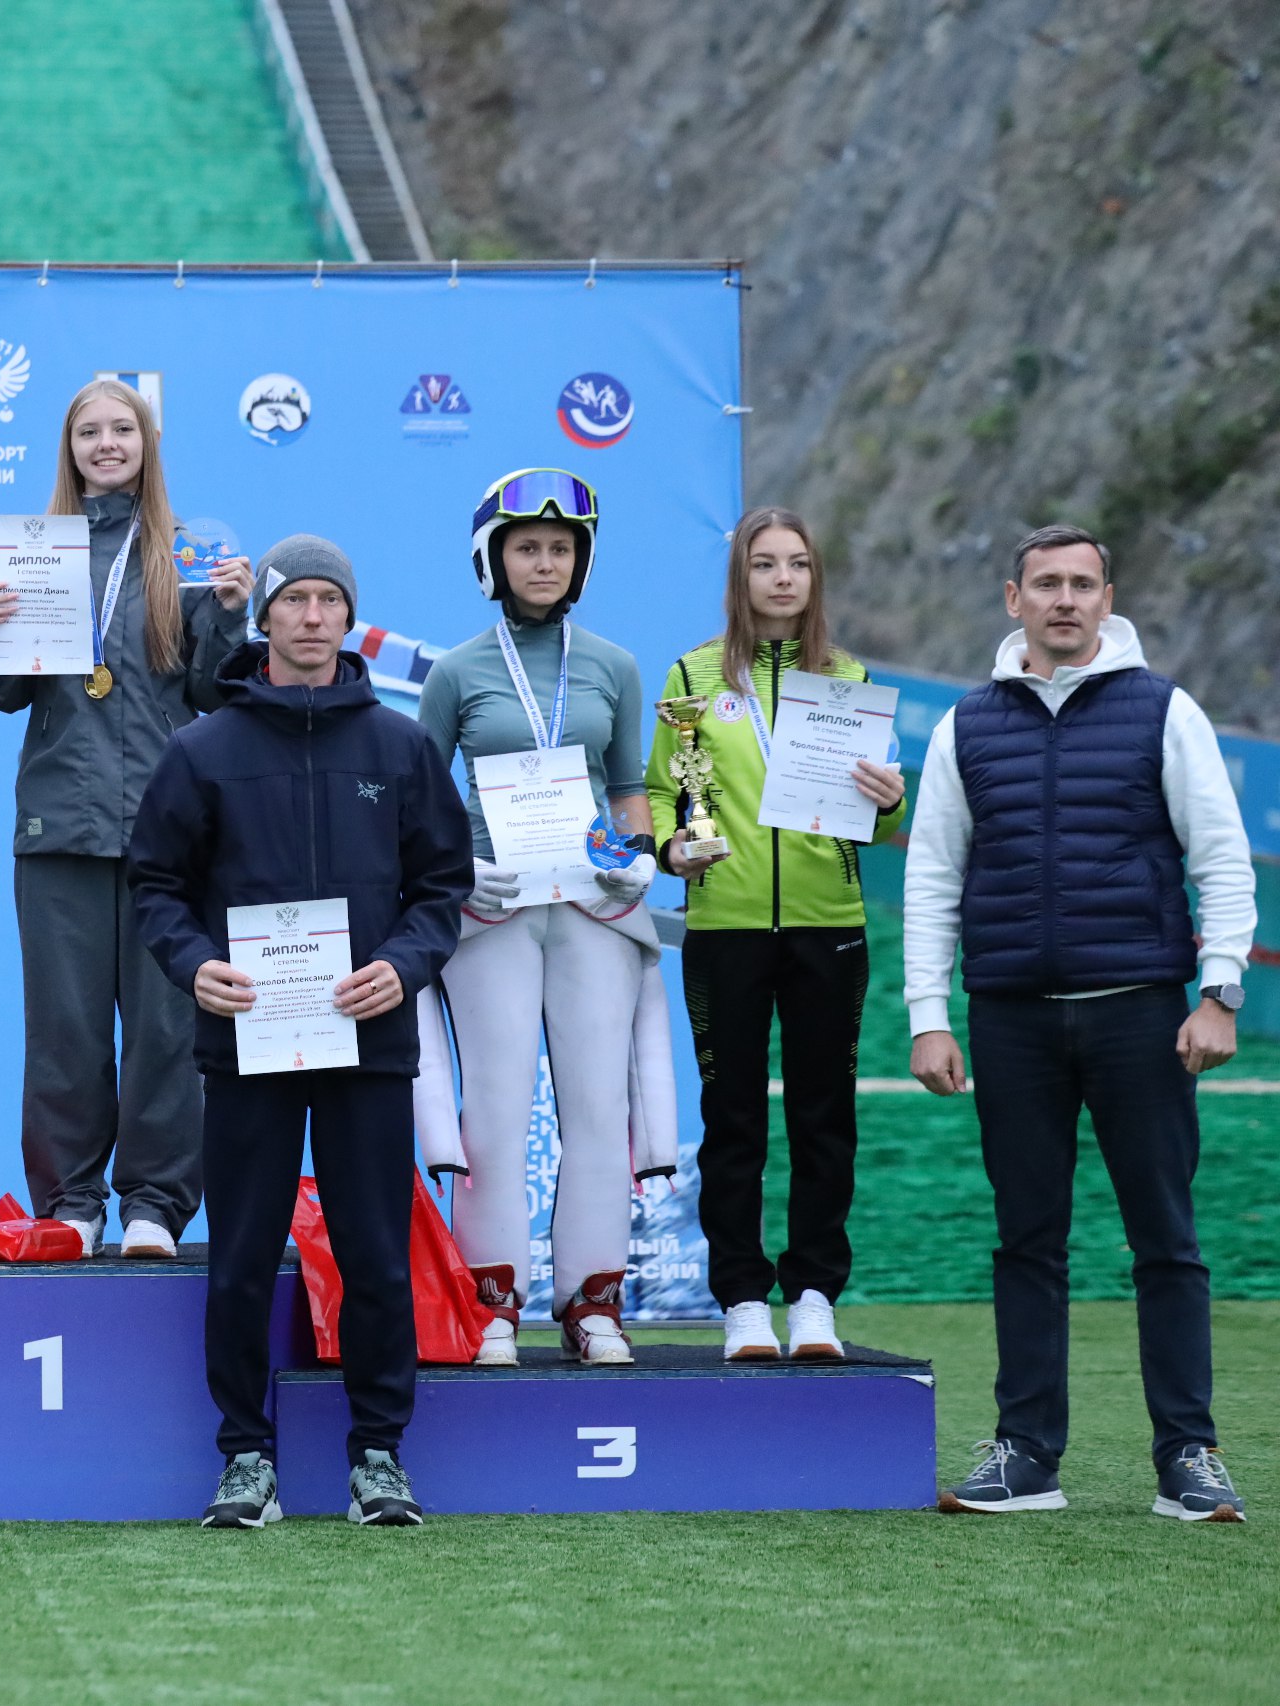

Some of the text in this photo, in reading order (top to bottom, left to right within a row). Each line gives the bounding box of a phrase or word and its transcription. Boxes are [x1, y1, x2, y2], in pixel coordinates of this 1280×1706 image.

[8, 556, 61, 566] ДИПЛОМ
[44, 587, 70, 595] Диана
[507, 650, 520, 673] СПОРТА
[747, 694, 758, 713] СПОРТ
[807, 712, 863, 729] ДИПЛОМ
[789, 740, 868, 760] Фролова Анастасия
[511, 789, 563, 804] ДИПЛОМ
[541, 816, 579, 825] Вероника
[261, 943, 319, 958] ДИПЛОМ
[251, 974, 334, 987] Соколов Александр
[625, 1263, 701, 1280] ССИИ
[23, 1335, 63, 1410] 1
[577, 1427, 637, 1478] 3
